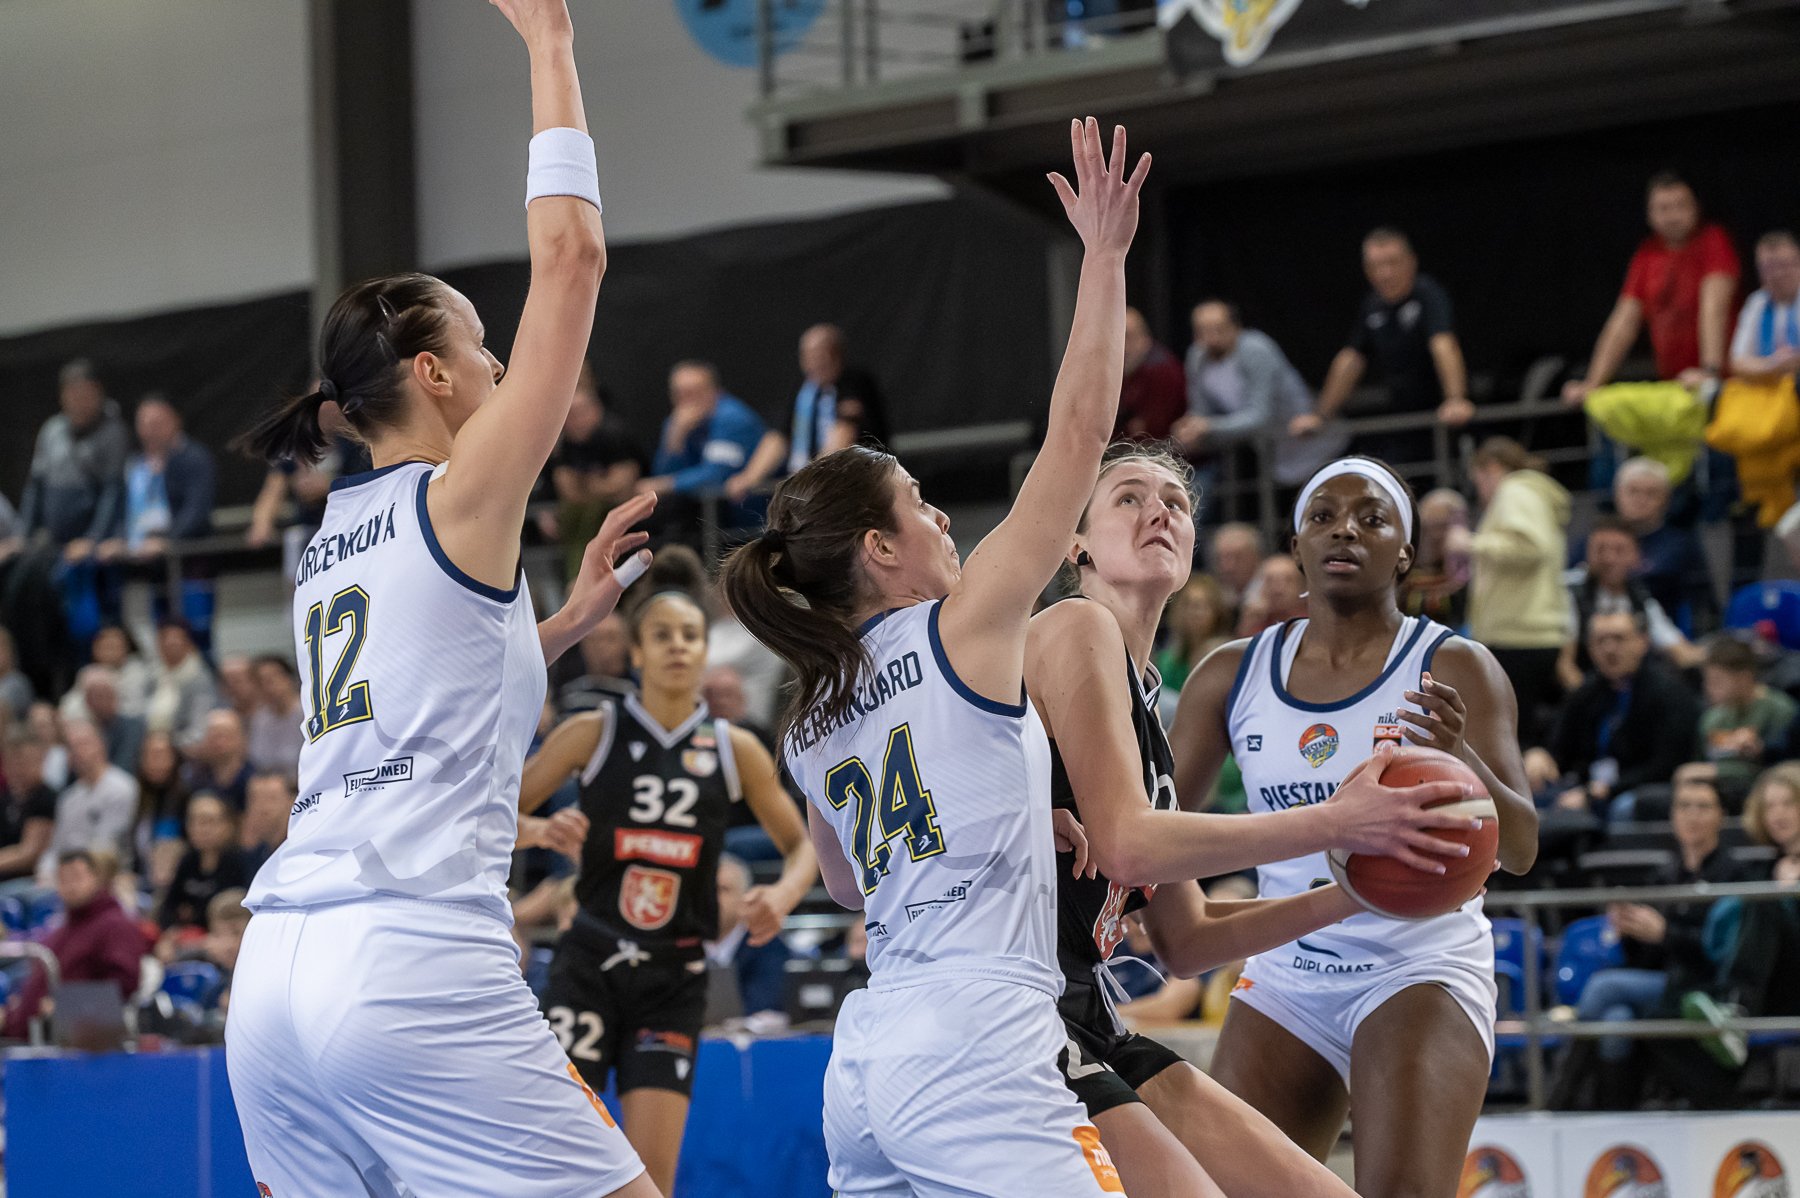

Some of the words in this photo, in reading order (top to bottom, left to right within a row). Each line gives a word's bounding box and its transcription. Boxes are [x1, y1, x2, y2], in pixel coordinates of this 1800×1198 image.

[304, 583, 374, 744] 12
[628, 774, 700, 828] 32
[824, 721, 948, 897] 24
[548, 1005, 605, 1063] 32
